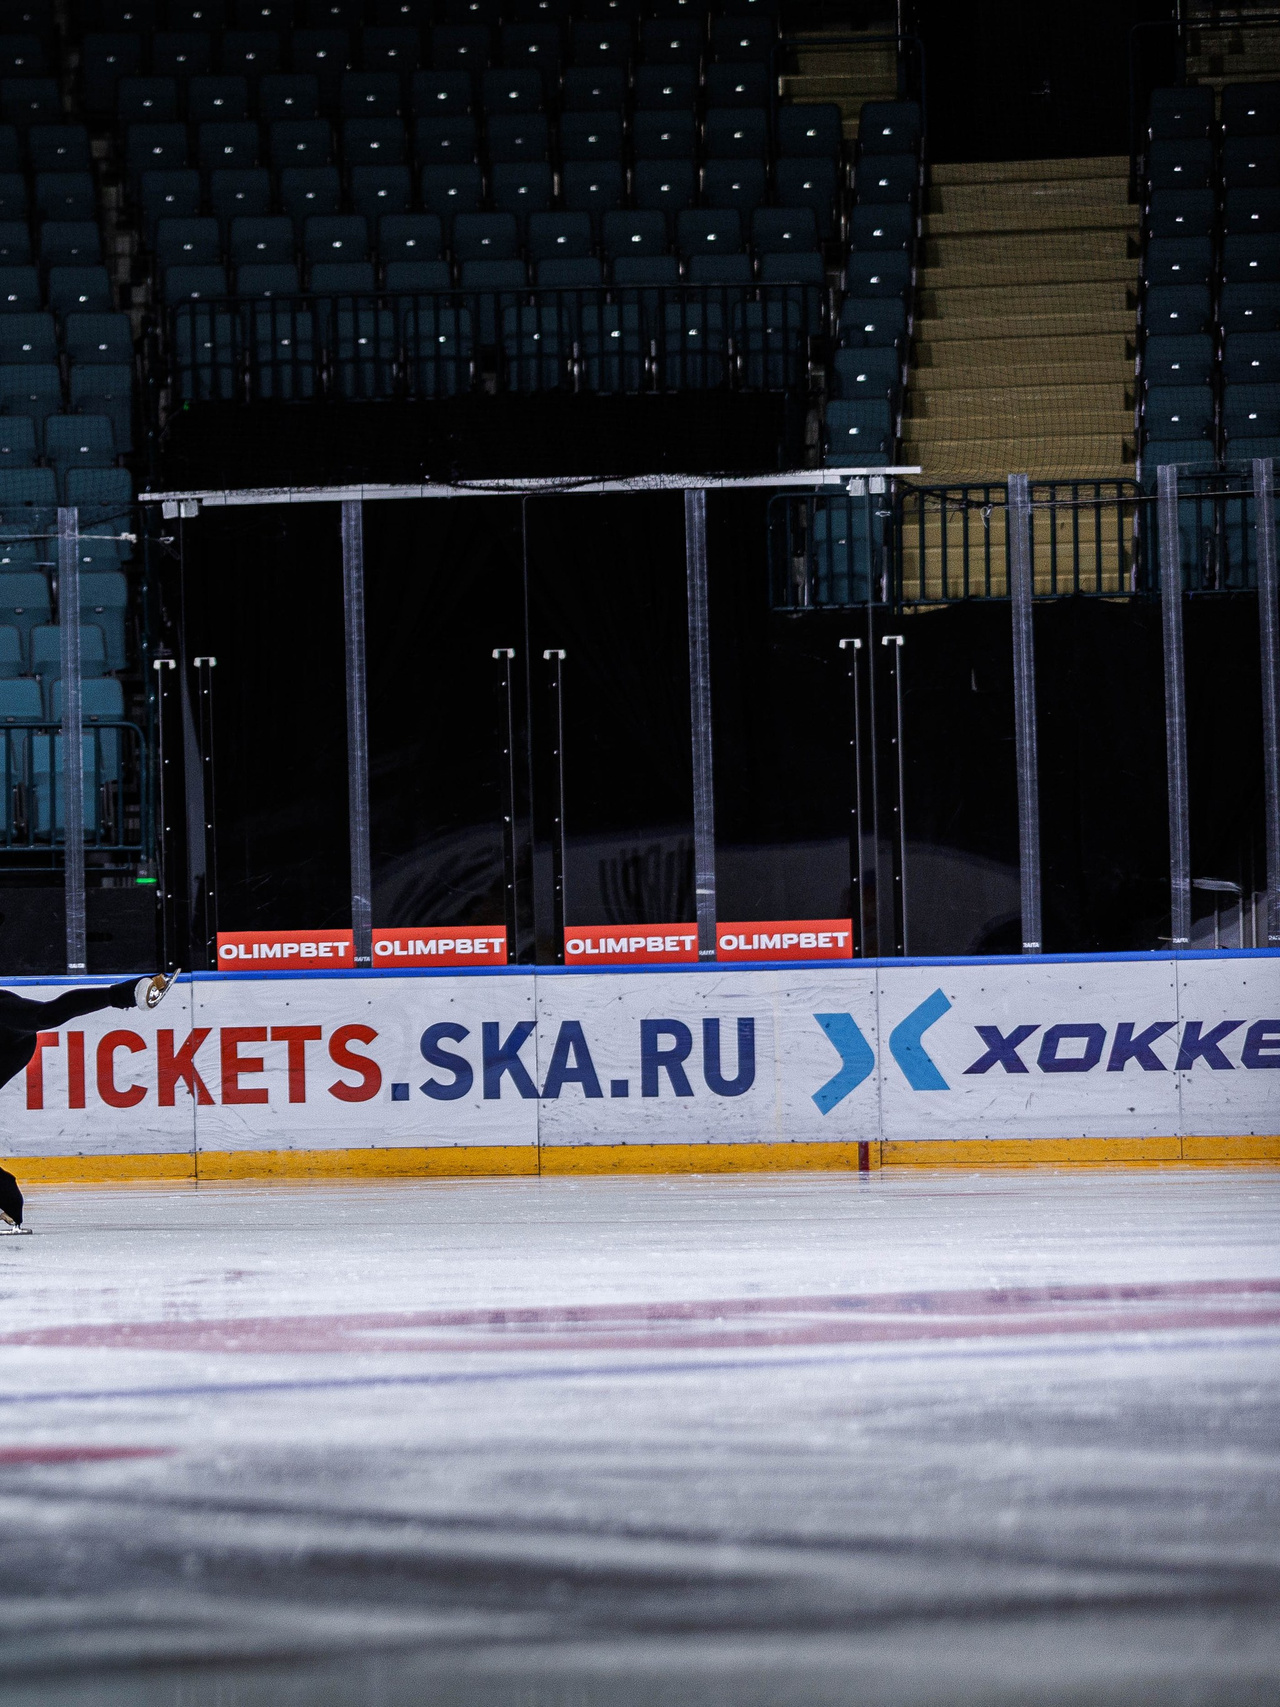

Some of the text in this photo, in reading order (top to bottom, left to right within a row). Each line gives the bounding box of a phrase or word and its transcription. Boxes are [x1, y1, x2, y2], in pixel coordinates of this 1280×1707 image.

[374, 938, 505, 956] OLIMPBET
[566, 935, 696, 954] OLIMPBET
[719, 931, 849, 950] OLIMPBET
[219, 942, 350, 959] OLIMPBET
[26, 1017, 756, 1109] TICKETS.SKA.RU
